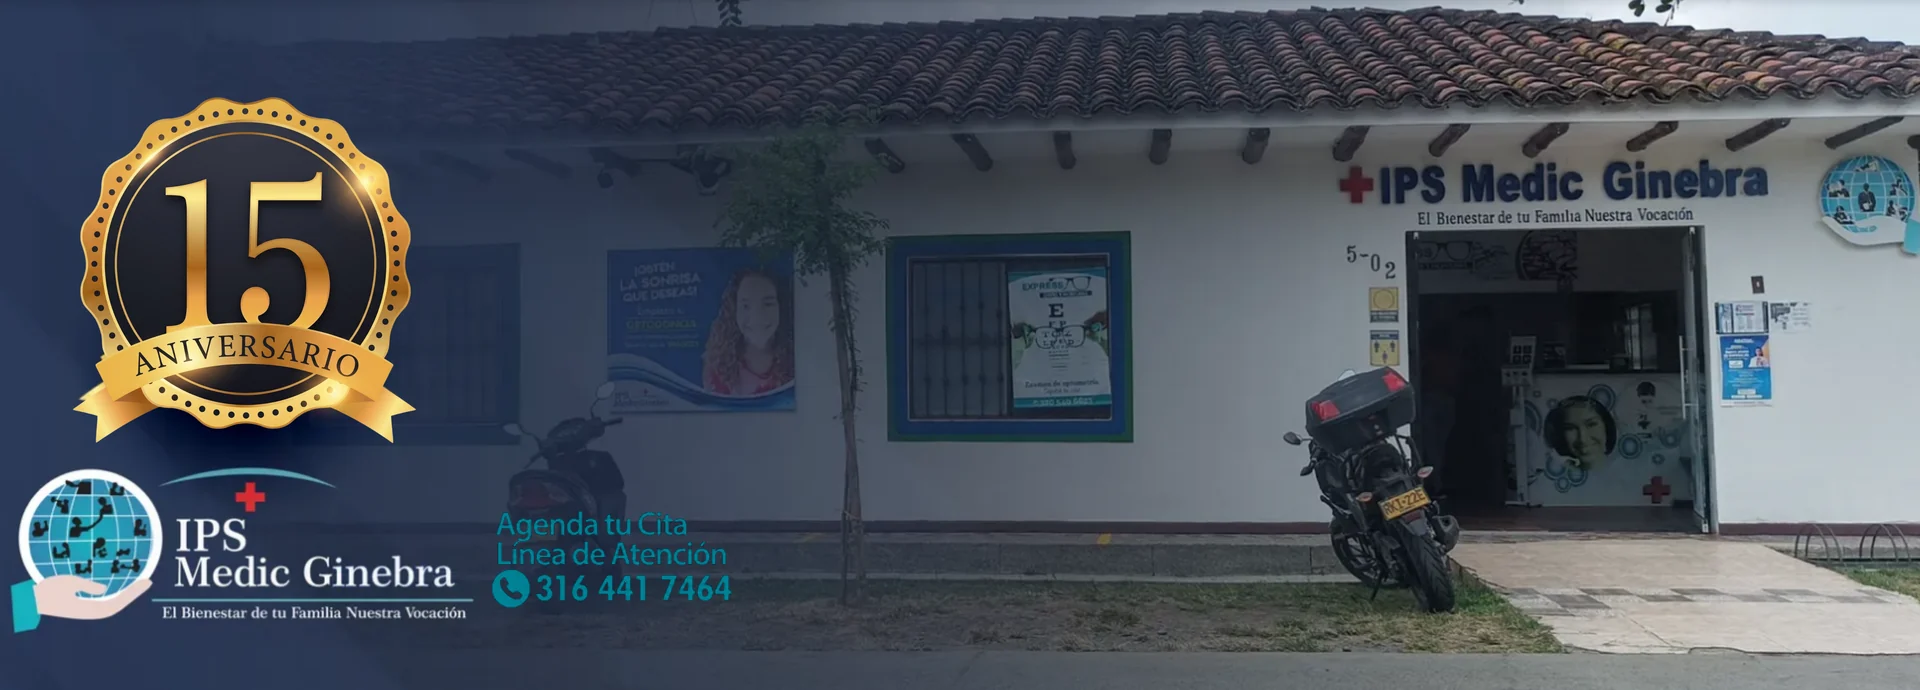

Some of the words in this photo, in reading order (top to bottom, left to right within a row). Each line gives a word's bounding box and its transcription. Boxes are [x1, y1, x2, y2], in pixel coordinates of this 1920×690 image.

[1381, 165, 1445, 204] IPS
[1462, 162, 1584, 203] Medic
[1603, 160, 1768, 201] Ginebra
[1418, 212, 1430, 225] El
[1437, 210, 1495, 225] Bienestar
[1498, 210, 1512, 224] de
[1517, 211, 1530, 224] tu
[1535, 210, 1581, 224] Familia
[1585, 209, 1632, 222] Nuestra
[1638, 207, 1693, 221] Vocación
[620, 279, 637, 292] LA
[642, 273, 700, 288] SONRISA
[1022, 281, 1064, 291] EXPRESS
[1048, 303, 1064, 317] E
